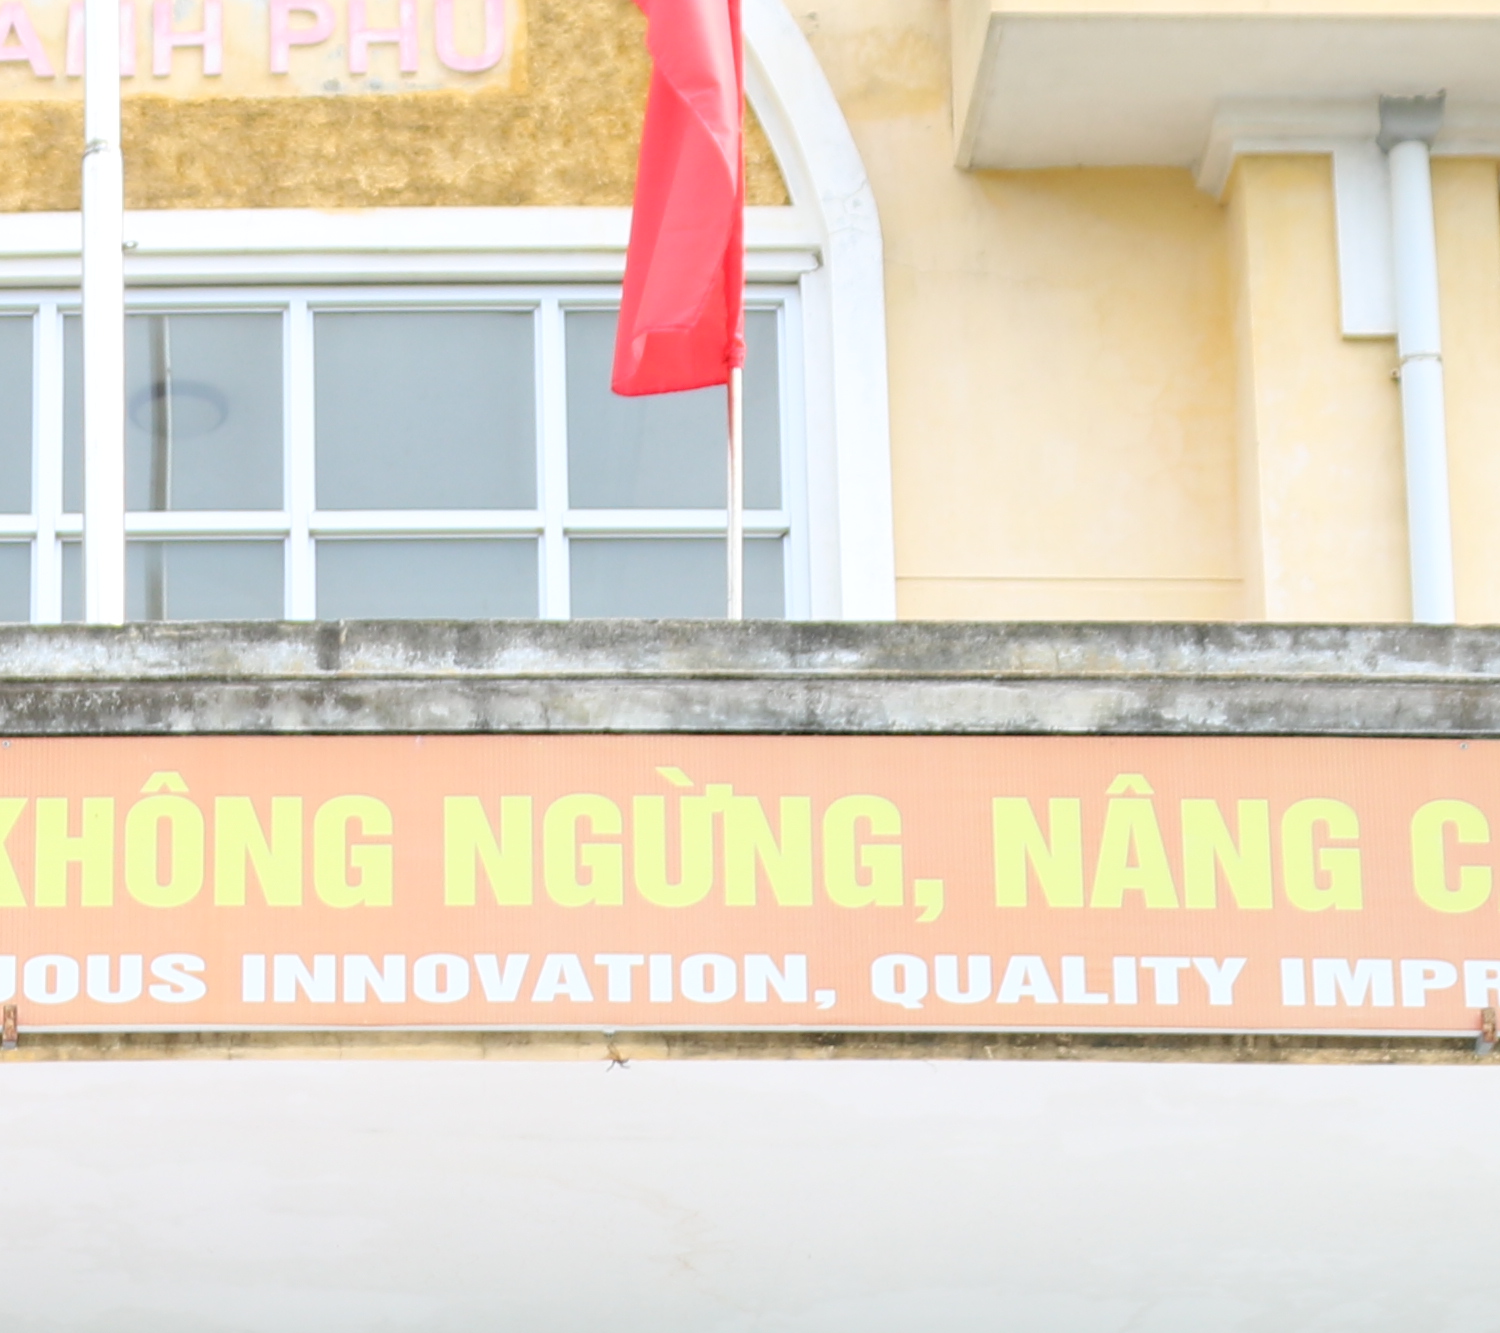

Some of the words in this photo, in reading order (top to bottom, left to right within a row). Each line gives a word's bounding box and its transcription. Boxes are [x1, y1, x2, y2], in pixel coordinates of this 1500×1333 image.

[443, 767, 945, 924] NGỪNG,
[993, 774, 1365, 914] NÂNG
[242, 953, 838, 1011] INNOVATION,
[871, 953, 1248, 1012] QUALITY
